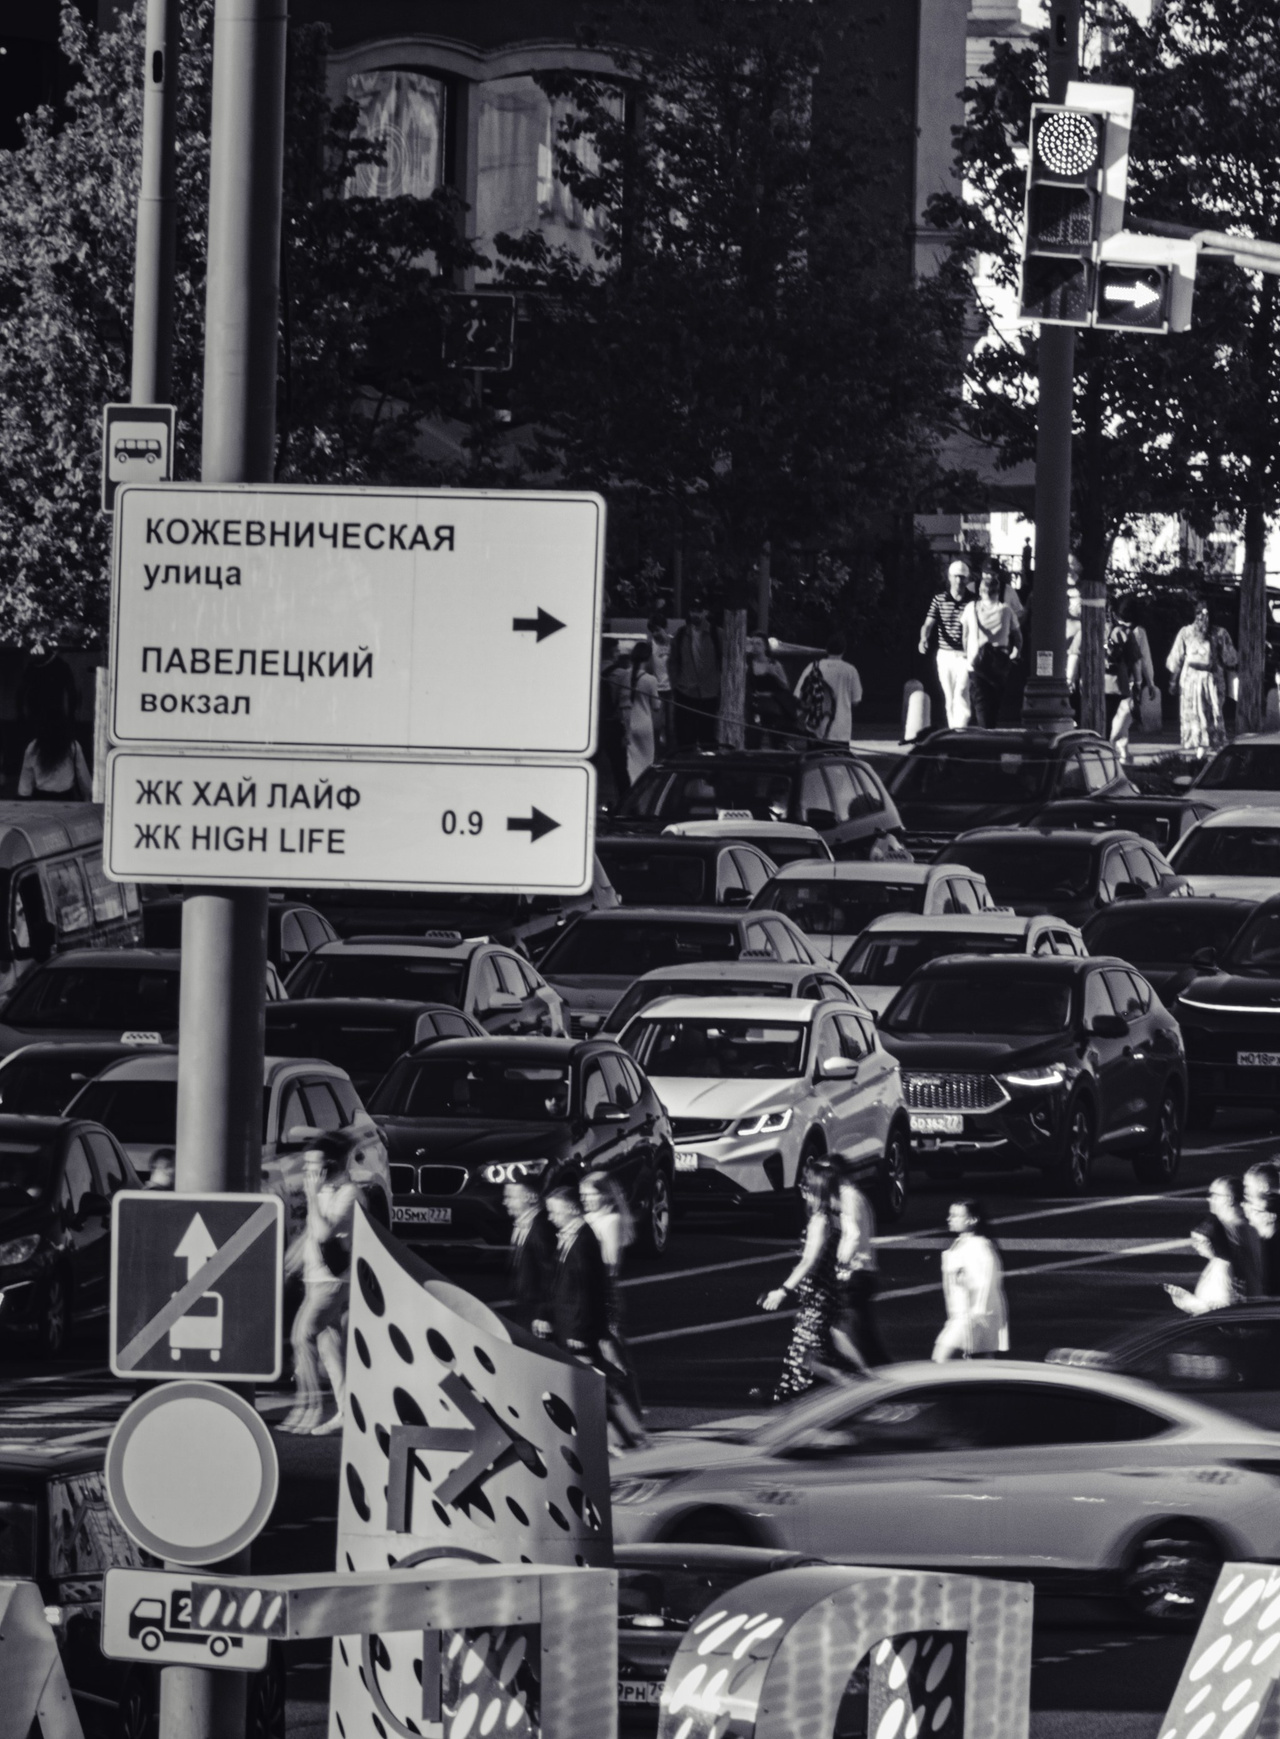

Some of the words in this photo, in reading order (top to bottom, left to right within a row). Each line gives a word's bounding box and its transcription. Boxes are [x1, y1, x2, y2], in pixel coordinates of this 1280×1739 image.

[145, 517, 455, 552] КОЖЕВНИЧЕСКАЯ
[143, 564, 242, 591] улица
[141, 646, 373, 683] ПАВЕЛЕЦКИЙ
[140, 693, 251, 715] вокзал
[136, 779, 183, 806] ЖК
[192, 776, 257, 808] ХАЙ
[266, 778, 361, 810] ЛАЙФ
[441, 810, 483, 836] 0.9
[134, 824, 181, 850] ЖК
[192, 825, 268, 852] HIGH
[280, 828, 345, 854] LIFE
